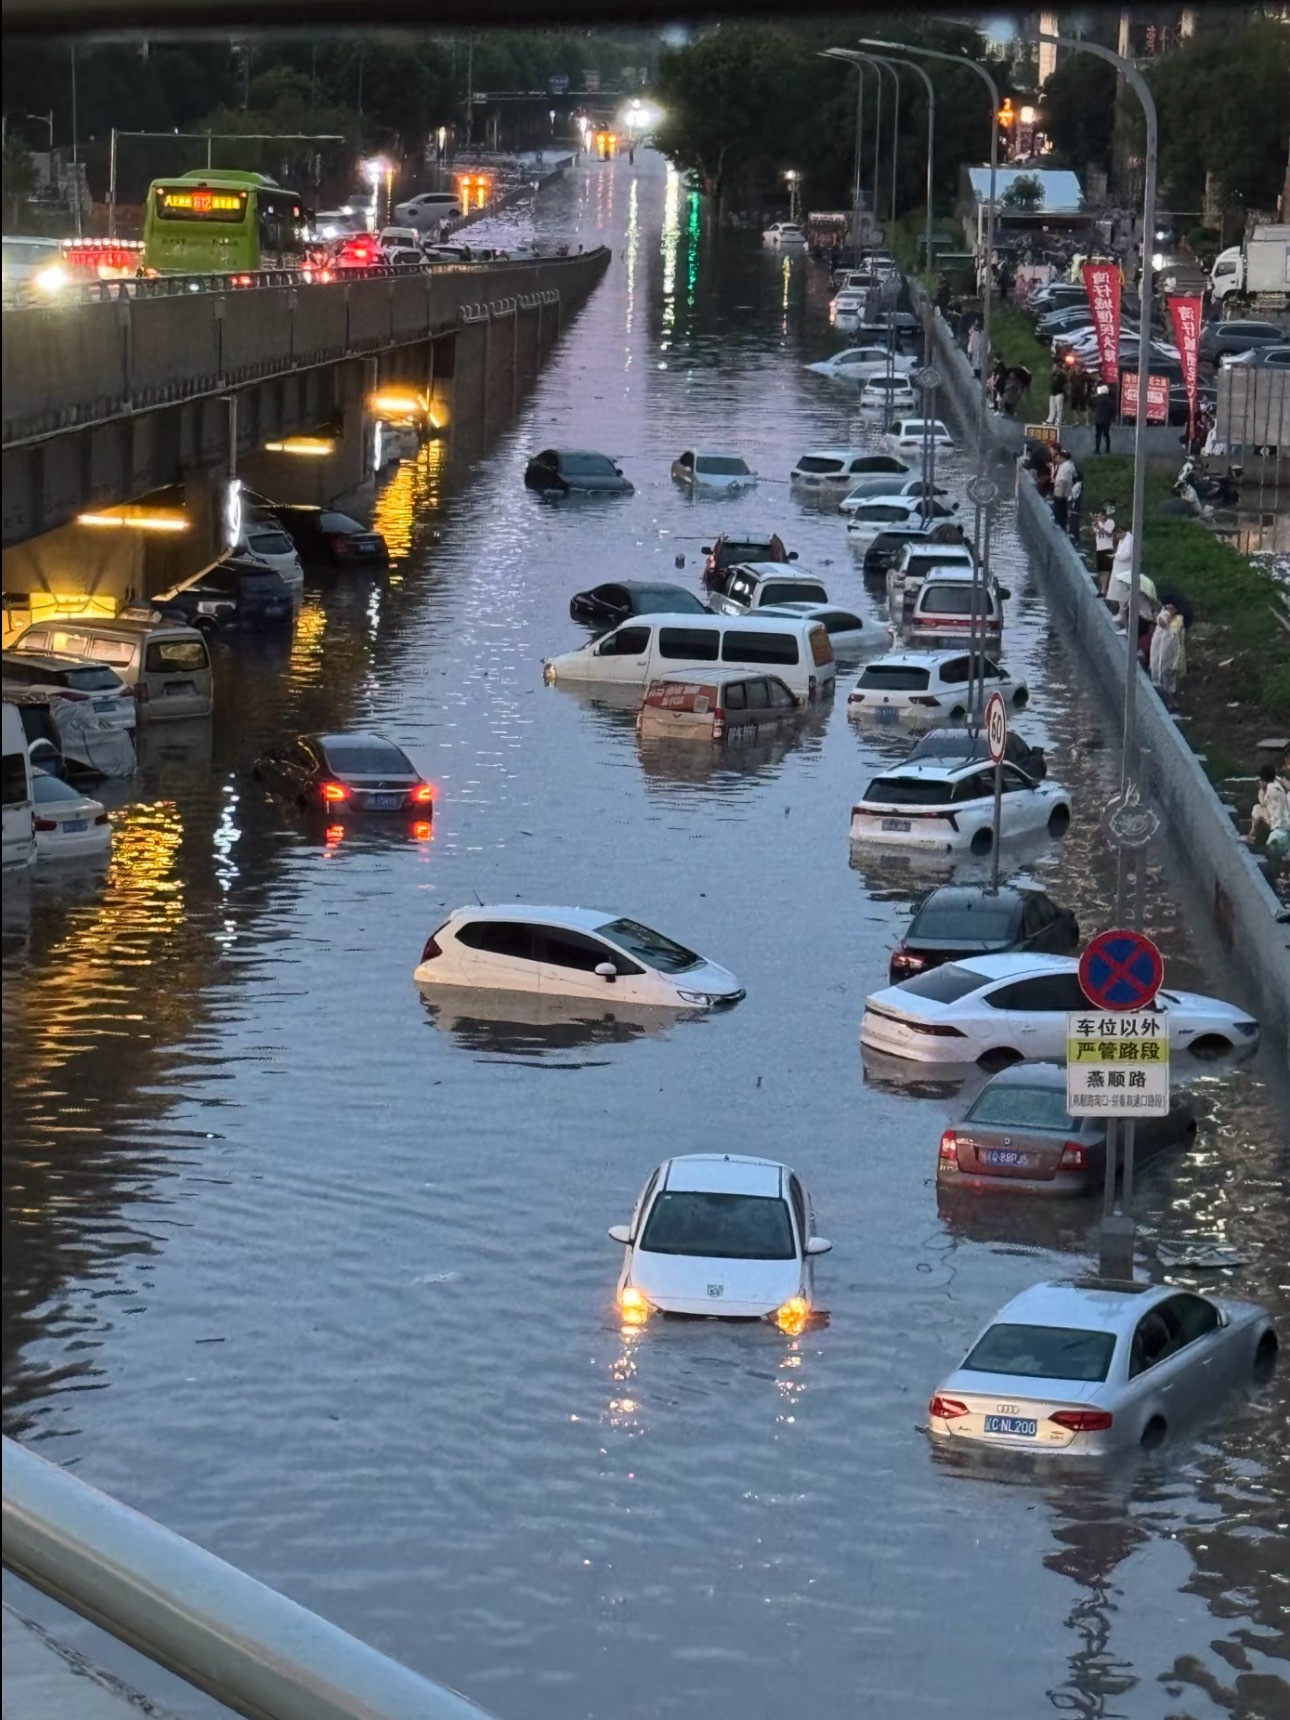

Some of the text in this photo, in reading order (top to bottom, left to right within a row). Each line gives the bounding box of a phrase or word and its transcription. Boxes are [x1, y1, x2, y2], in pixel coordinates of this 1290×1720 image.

[992, 711, 1002, 744] 60
[1076, 1018, 1160, 1037] 车位以外
[1076, 1041, 1160, 1060] 严管路段
[1087, 1070, 1147, 1089] 燕顺路
